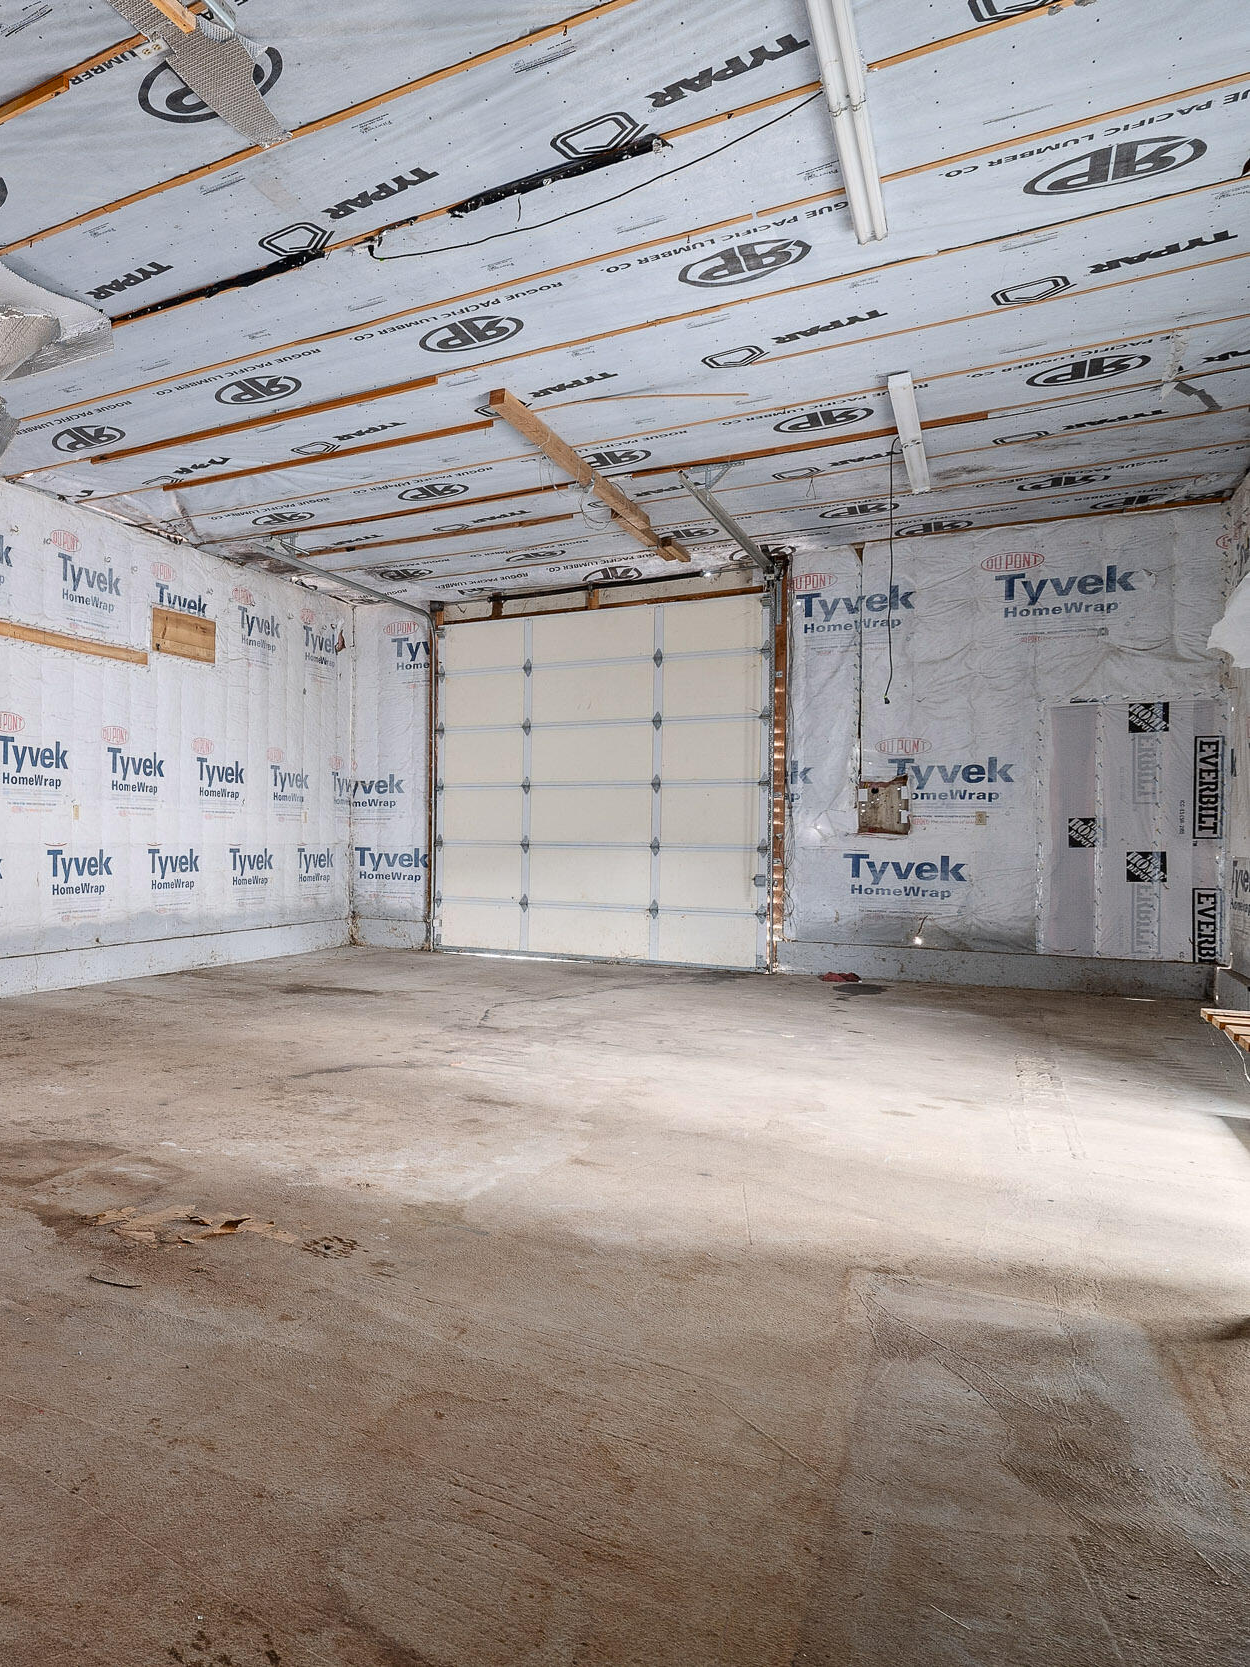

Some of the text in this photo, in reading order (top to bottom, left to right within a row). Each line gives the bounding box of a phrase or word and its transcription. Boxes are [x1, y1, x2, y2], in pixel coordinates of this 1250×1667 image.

[645, 34, 811, 108] TYPAR
[322, 167, 440, 220] TYPAR
[1088, 230, 1238, 275] TYPAR
[85, 261, 174, 300] TYPAR
[506, 282, 564, 302] ROGUE
[443, 298, 501, 319] PACIFIC
[772, 308, 888, 345] TYPAR
[275, 349, 321, 363] ROGUE
[528, 372, 618, 398] TYPAR
[58, 552, 121, 596] Tyvek
[995, 565, 1137, 605] Tyvek
[62, 588, 115, 613] HomeWrap
[1004, 602, 1119, 618] HomeWrap
[238, 605, 281, 639] Tyvek
[303, 626, 335, 653] Tyve
[391, 637, 430, 662] Tyv
[396, 662, 430, 671] Home
[108, 747, 164, 780] Tyvek
[197, 757, 244, 787] Tyvek
[2, 772, 61, 789] HomeWrap
[111, 780, 158, 795] HomeWrap
[1199, 739, 1219, 835] EVERBILT
[200, 787, 239, 800] HomeWrap
[352, 799, 397, 809] meWrap
[910, 790, 1000, 802] omeWrap
[1069, 818, 1097, 843] HOM
[47, 849, 113, 883] Tyvek
[148, 848, 199, 879] Tyvek
[229, 848, 273, 876] Tyvek
[298, 848, 333, 873] Tyvek
[843, 853, 967, 884] Tyvek
[52, 882, 105, 895] HomeWrap
[151, 879, 195, 890] HomeWrap
[232, 875, 268, 886] HomeWrap
[359, 871, 421, 882] HomeWrap
[850, 884, 952, 900] HomeWrap
[1197, 893, 1217, 962] EVERB
